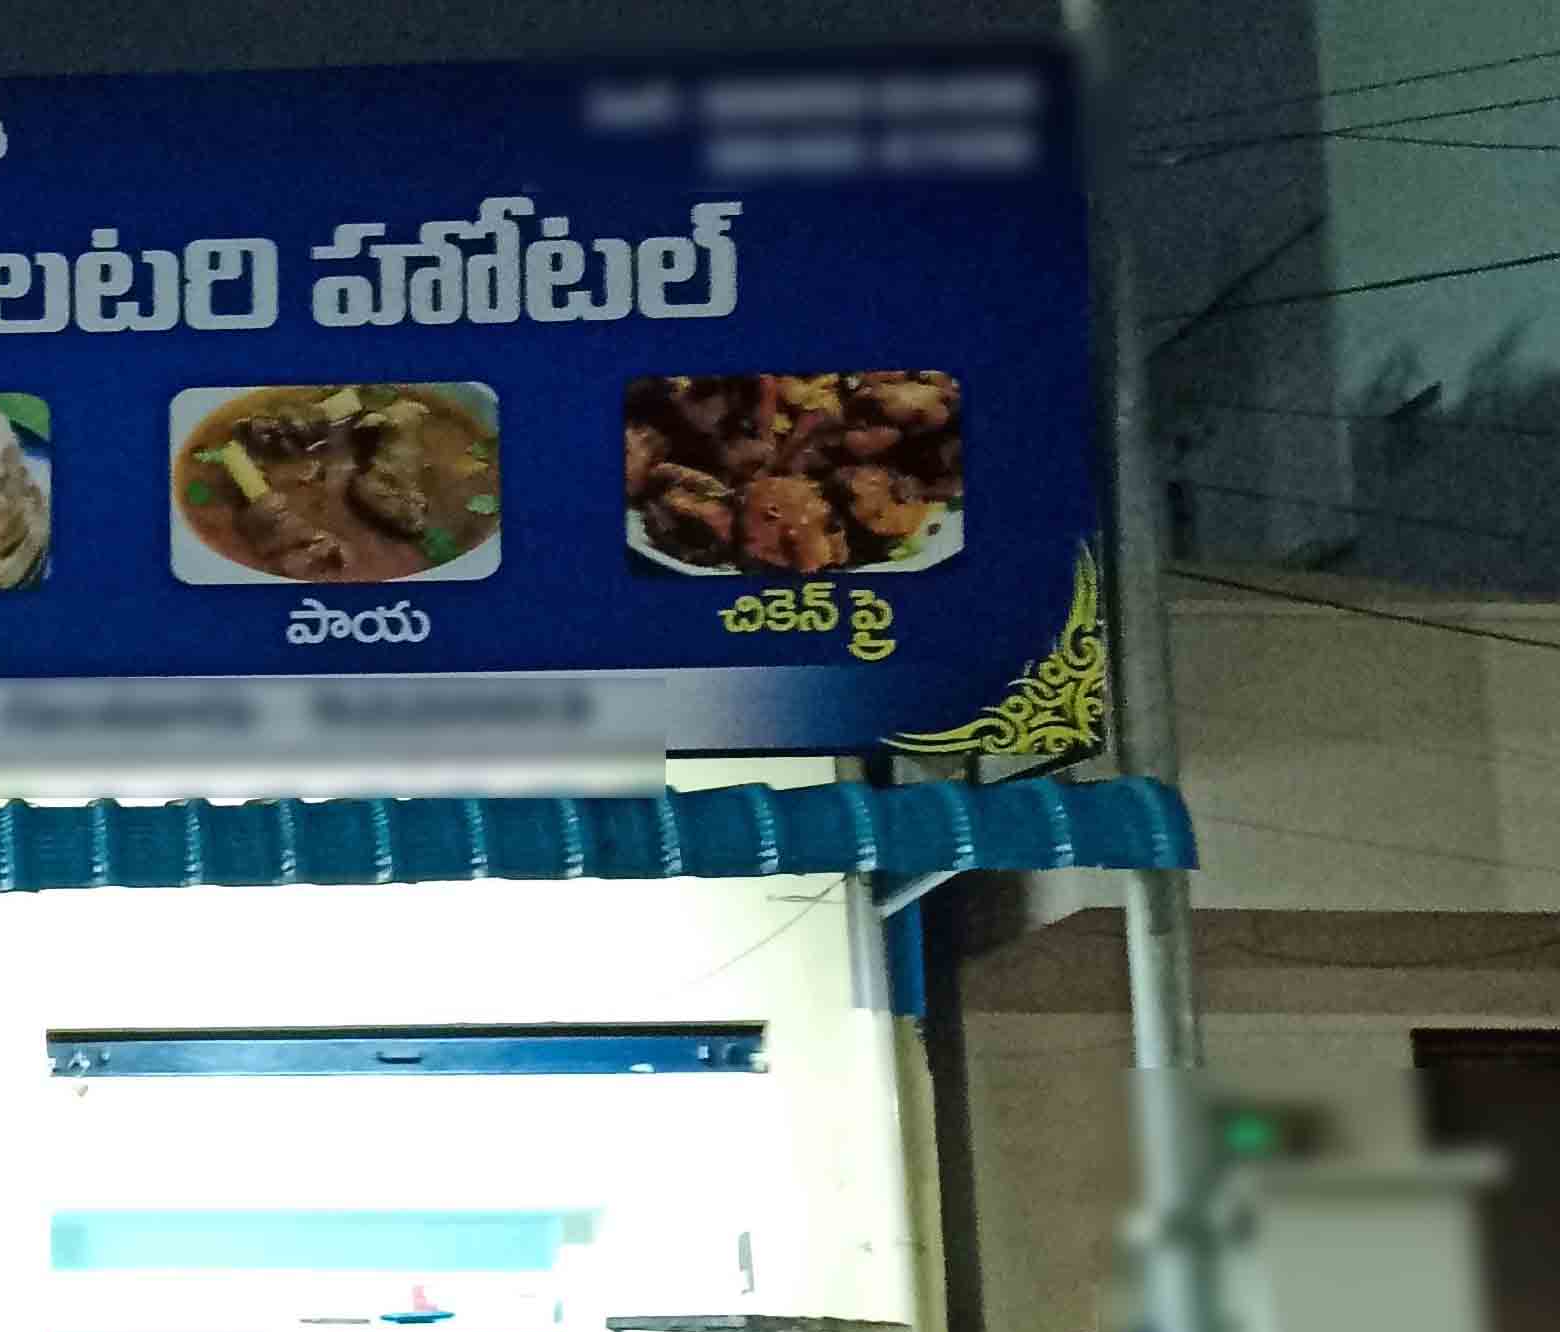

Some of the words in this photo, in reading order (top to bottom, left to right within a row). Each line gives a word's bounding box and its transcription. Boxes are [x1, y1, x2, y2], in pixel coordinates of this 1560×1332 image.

[312, 196, 743, 326] హోటల్
[286, 598, 431, 644] పాయ
[717, 582, 839, 632] చికెన్
